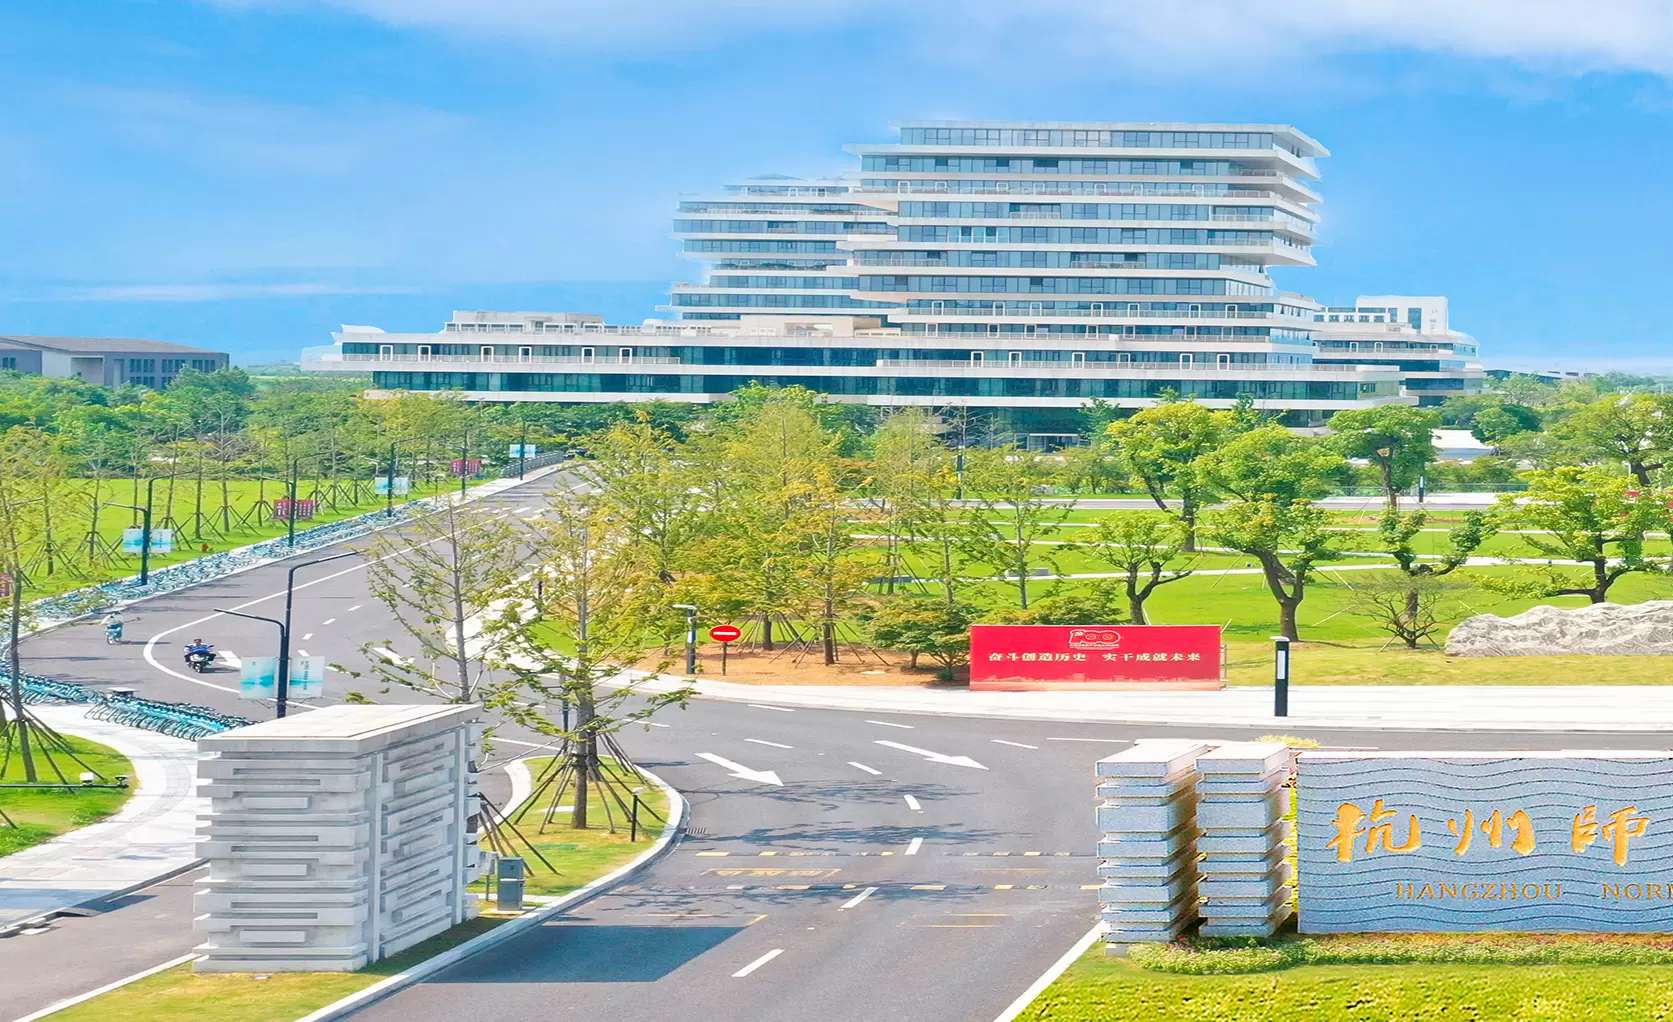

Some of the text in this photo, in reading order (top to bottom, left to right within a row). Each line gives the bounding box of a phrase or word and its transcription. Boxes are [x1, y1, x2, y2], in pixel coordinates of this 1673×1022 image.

[988, 652, 1201, 662] 奋斗创造历史 实干成就未来
[1396, 883, 1562, 900] HANGZHOU
